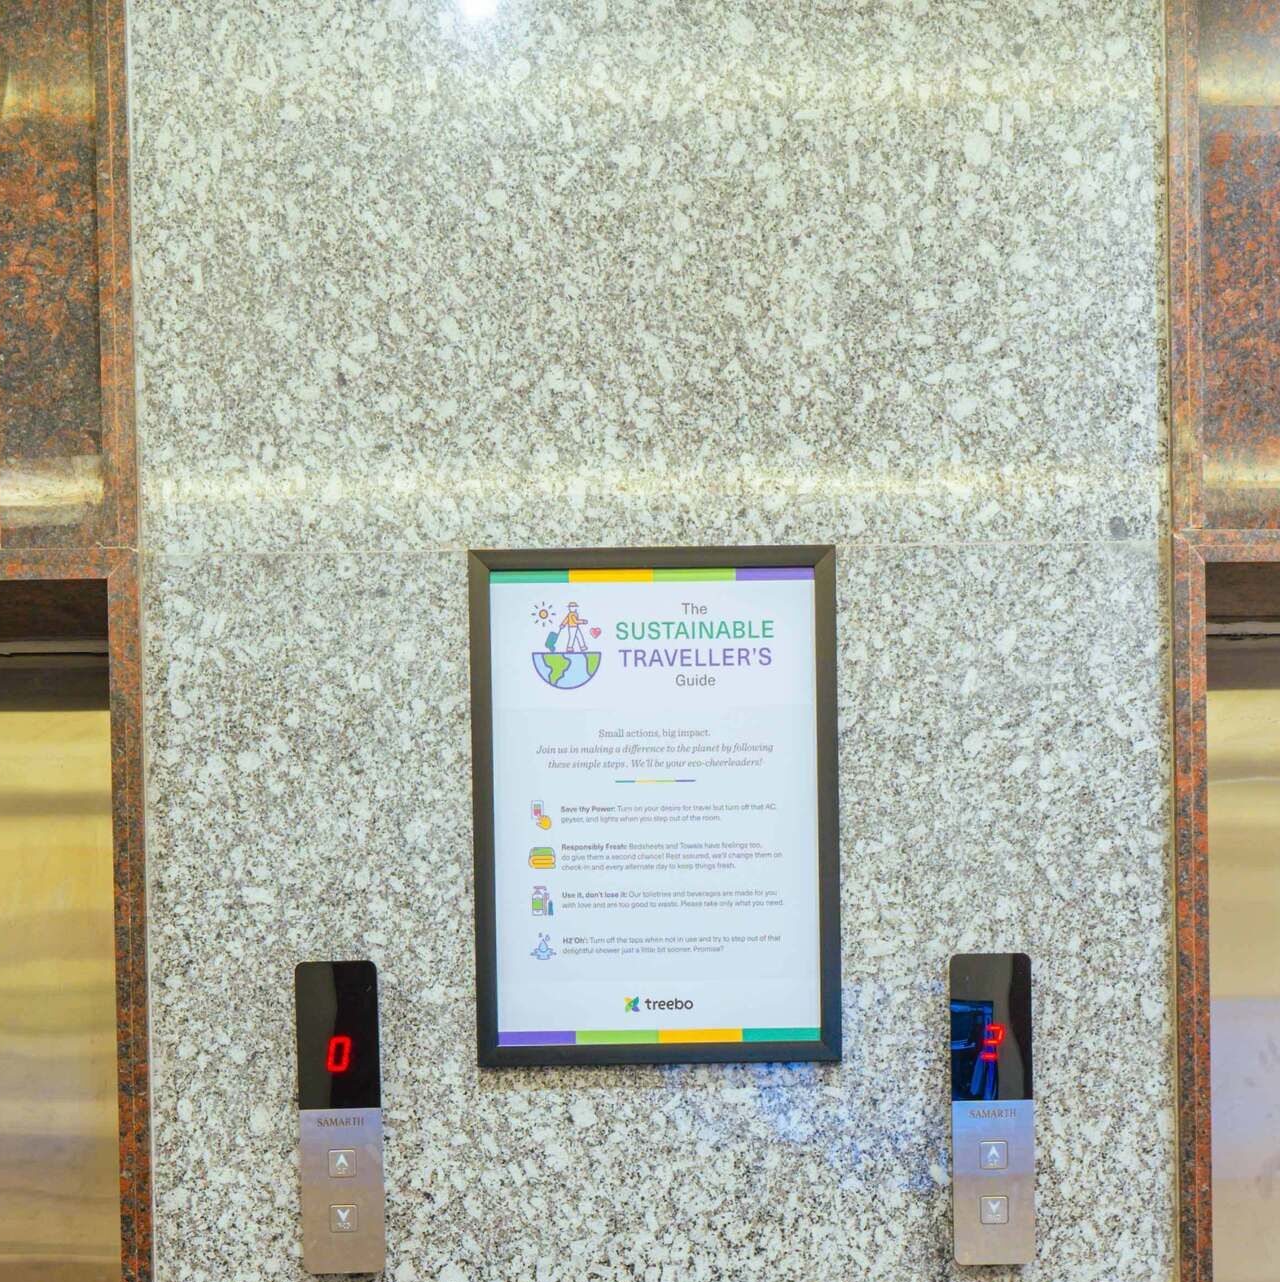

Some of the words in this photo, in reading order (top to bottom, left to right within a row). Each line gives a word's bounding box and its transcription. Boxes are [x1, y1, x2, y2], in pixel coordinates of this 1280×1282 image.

[681, 603, 707, 615] The
[615, 620, 774, 640] SUSTAINABLE
[619, 647, 772, 668] TRAVELLER'S
[675, 674, 716, 687] Guide
[598, 729, 624, 738] Small
[626, 728, 660, 741] actions,
[662, 728, 677, 740] big
[677, 728, 711, 740] impact.
[536, 745, 555, 753] Join
[569, 745, 579, 753] in
[580, 744, 613, 756] making
[622, 744, 664, 753] difference
[666, 744, 675, 752] to
[676, 744, 690, 752] the
[692, 743, 719, 755] planet
[720, 743, 731, 755] by
[732, 743, 774, 755] following
[547, 760, 570, 768] these
[572, 759, 601, 771] simple
[654, 759, 664, 767] be
[665, 761, 686, 770] your
[687, 758, 764, 767] eco-cheerleaders!
[645, 997, 694, 1010] treebo
[326, 1035, 351, 1073] 0
[969, 1109, 1016, 1118] SAMARTH
[317, 1117, 364, 1127] SAMARTH
